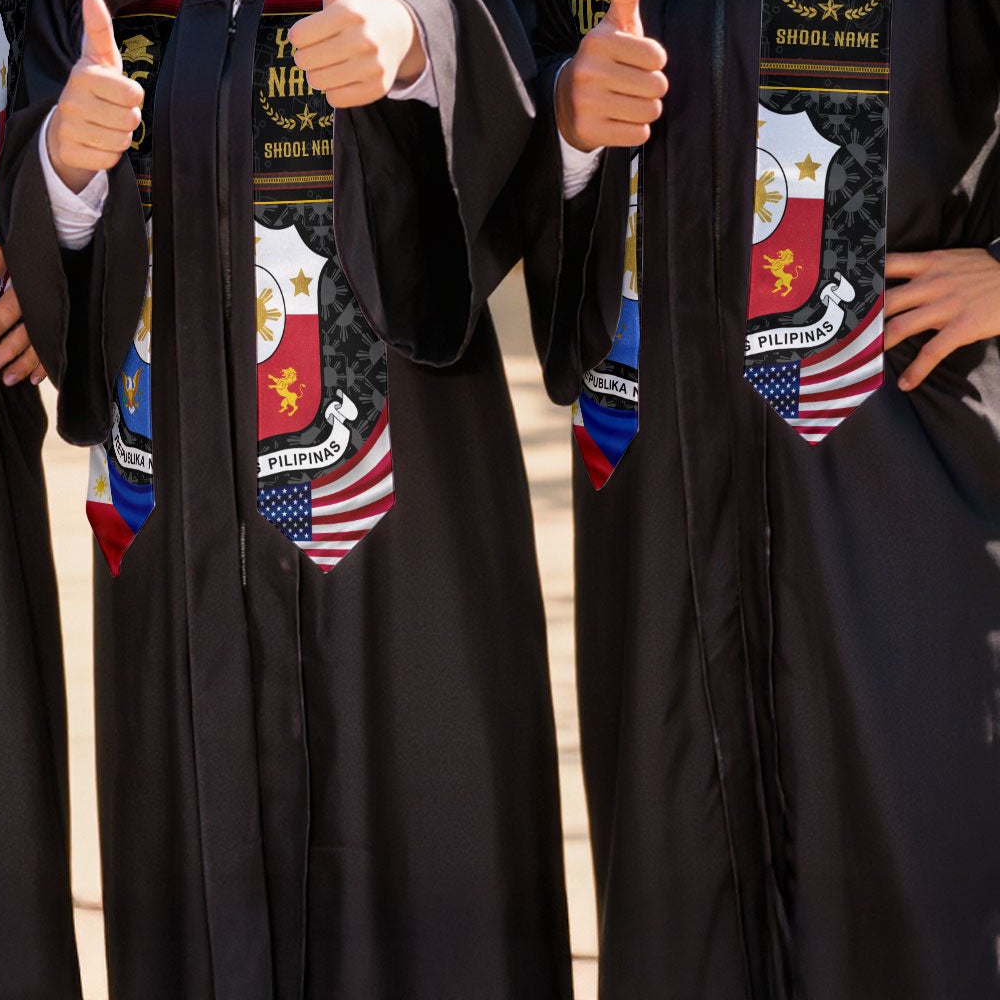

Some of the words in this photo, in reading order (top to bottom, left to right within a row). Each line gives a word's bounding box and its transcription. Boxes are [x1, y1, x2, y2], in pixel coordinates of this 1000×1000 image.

[776, 28, 829, 46] SHOOL
[834, 30, 879, 49] NAME
[268, 66, 326, 98] NA
[264, 140, 309, 159] SHOOL
[758, 321, 834, 348] PILIPINAS
[268, 440, 341, 470] PILIPINAS
